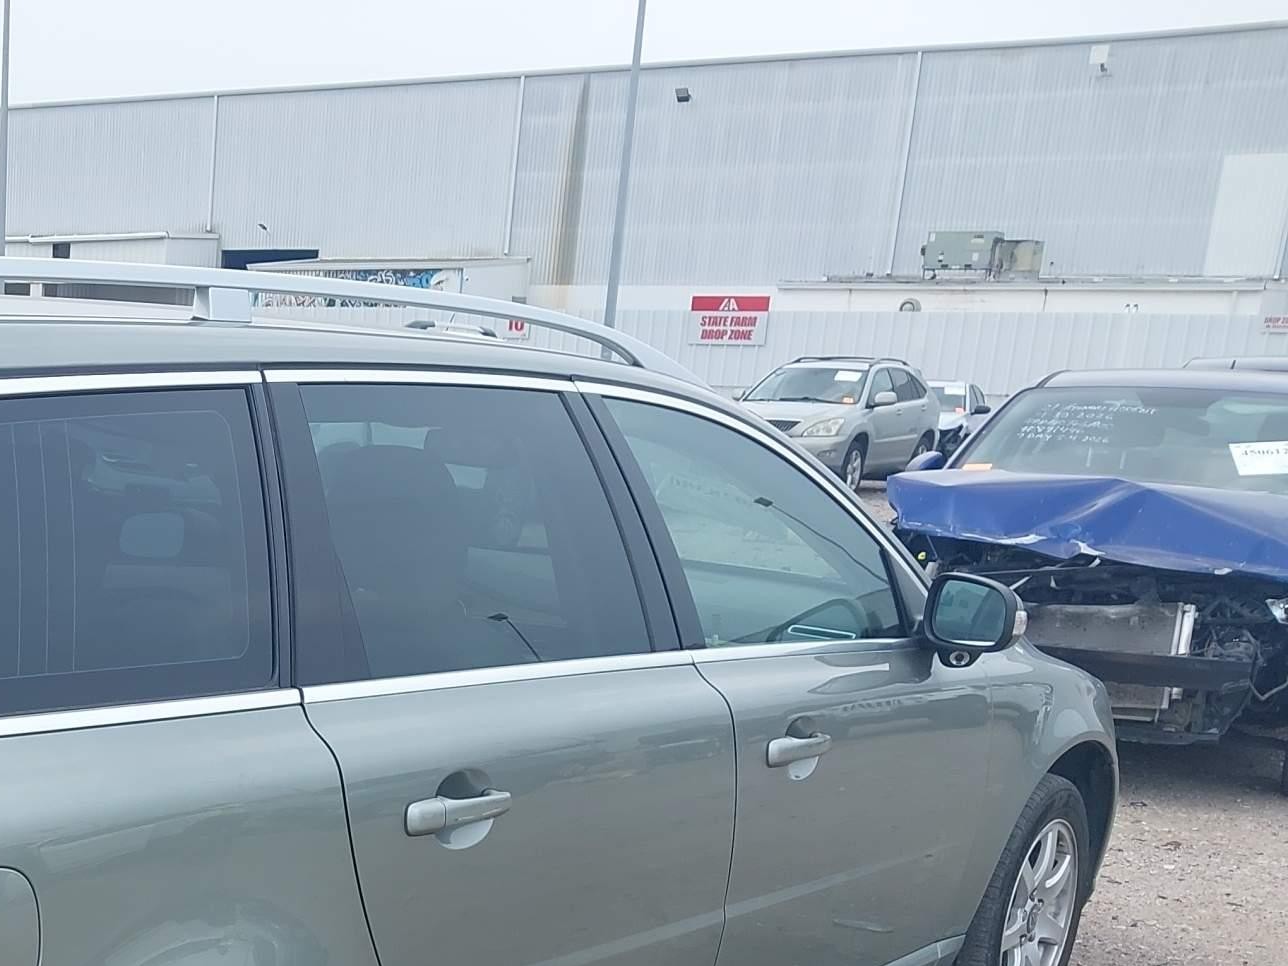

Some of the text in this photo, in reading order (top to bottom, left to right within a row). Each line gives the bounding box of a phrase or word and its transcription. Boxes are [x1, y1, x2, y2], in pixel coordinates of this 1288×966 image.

[700, 316, 758, 327] STATE FARM
[700, 329, 753, 340] DROP ZONE
